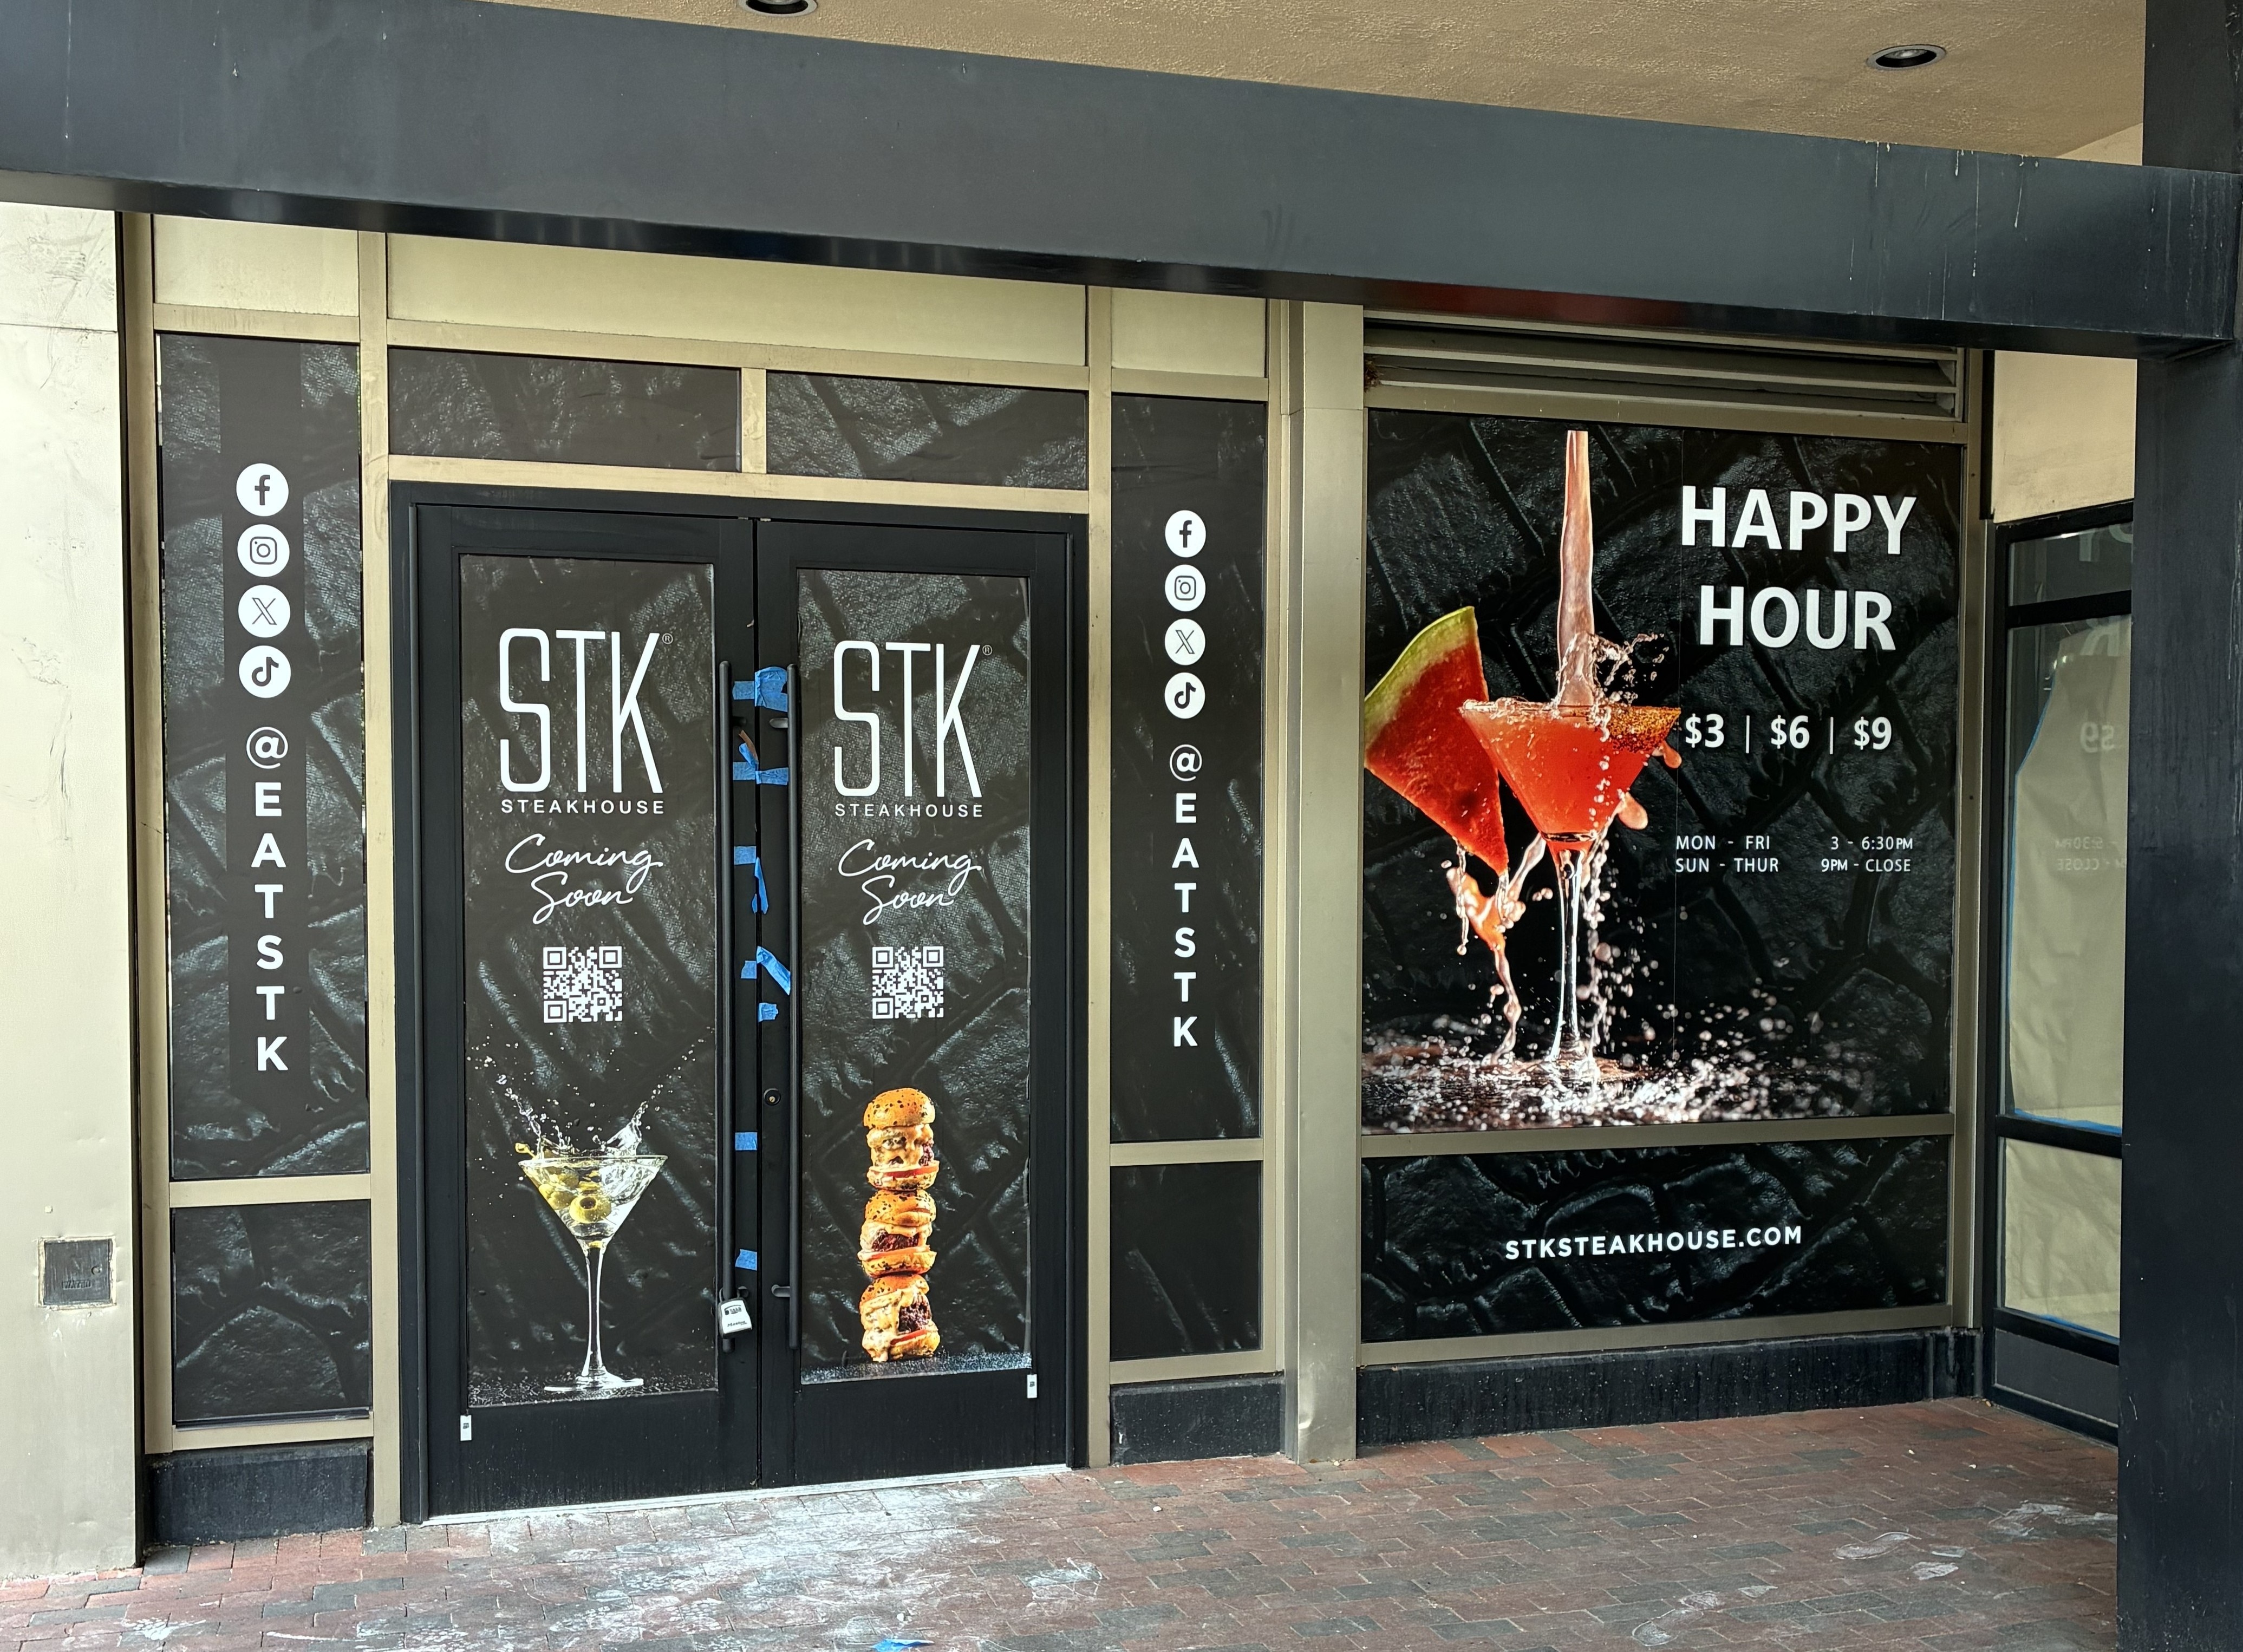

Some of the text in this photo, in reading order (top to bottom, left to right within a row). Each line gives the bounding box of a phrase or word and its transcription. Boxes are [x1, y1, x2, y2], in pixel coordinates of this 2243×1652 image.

[1682, 486, 1916, 554] HAPPY
[1700, 585, 1895, 650] HOUR
[497, 628, 663, 794] STK
[833, 640, 982, 798] STK
[1686, 714, 1724, 748] $3
[1771, 715, 1809, 749] $6
[1855, 717, 1891, 750] $9
[501, 799, 664, 815] STEAKHOUSE
[835, 804, 983, 818] STEAKHOUSE
[505, 833, 664, 893] Coming
[838, 839, 982, 897] Coming
[1676, 858, 1709, 872] SUN
[1734, 858, 1778, 872] THUR
[1821, 859, 1847, 872] 9PM
[1866, 859, 1911, 872] CLOSE
[1677, 835, 1715, 850] MON
[1746, 836, 1769, 849] FRI
[1831, 837, 1838, 850] 3
[1862, 837, 1912, 850] 6:30PM
[246, 727, 288, 1070] @EATSTK
[530, 871, 634, 925] Soon
[861, 874, 955, 926] Soon
[1170, 745, 1202, 1047] @EATSTK
[1506, 1226, 1801, 1259] STKSTEAKHOUSE.COM
